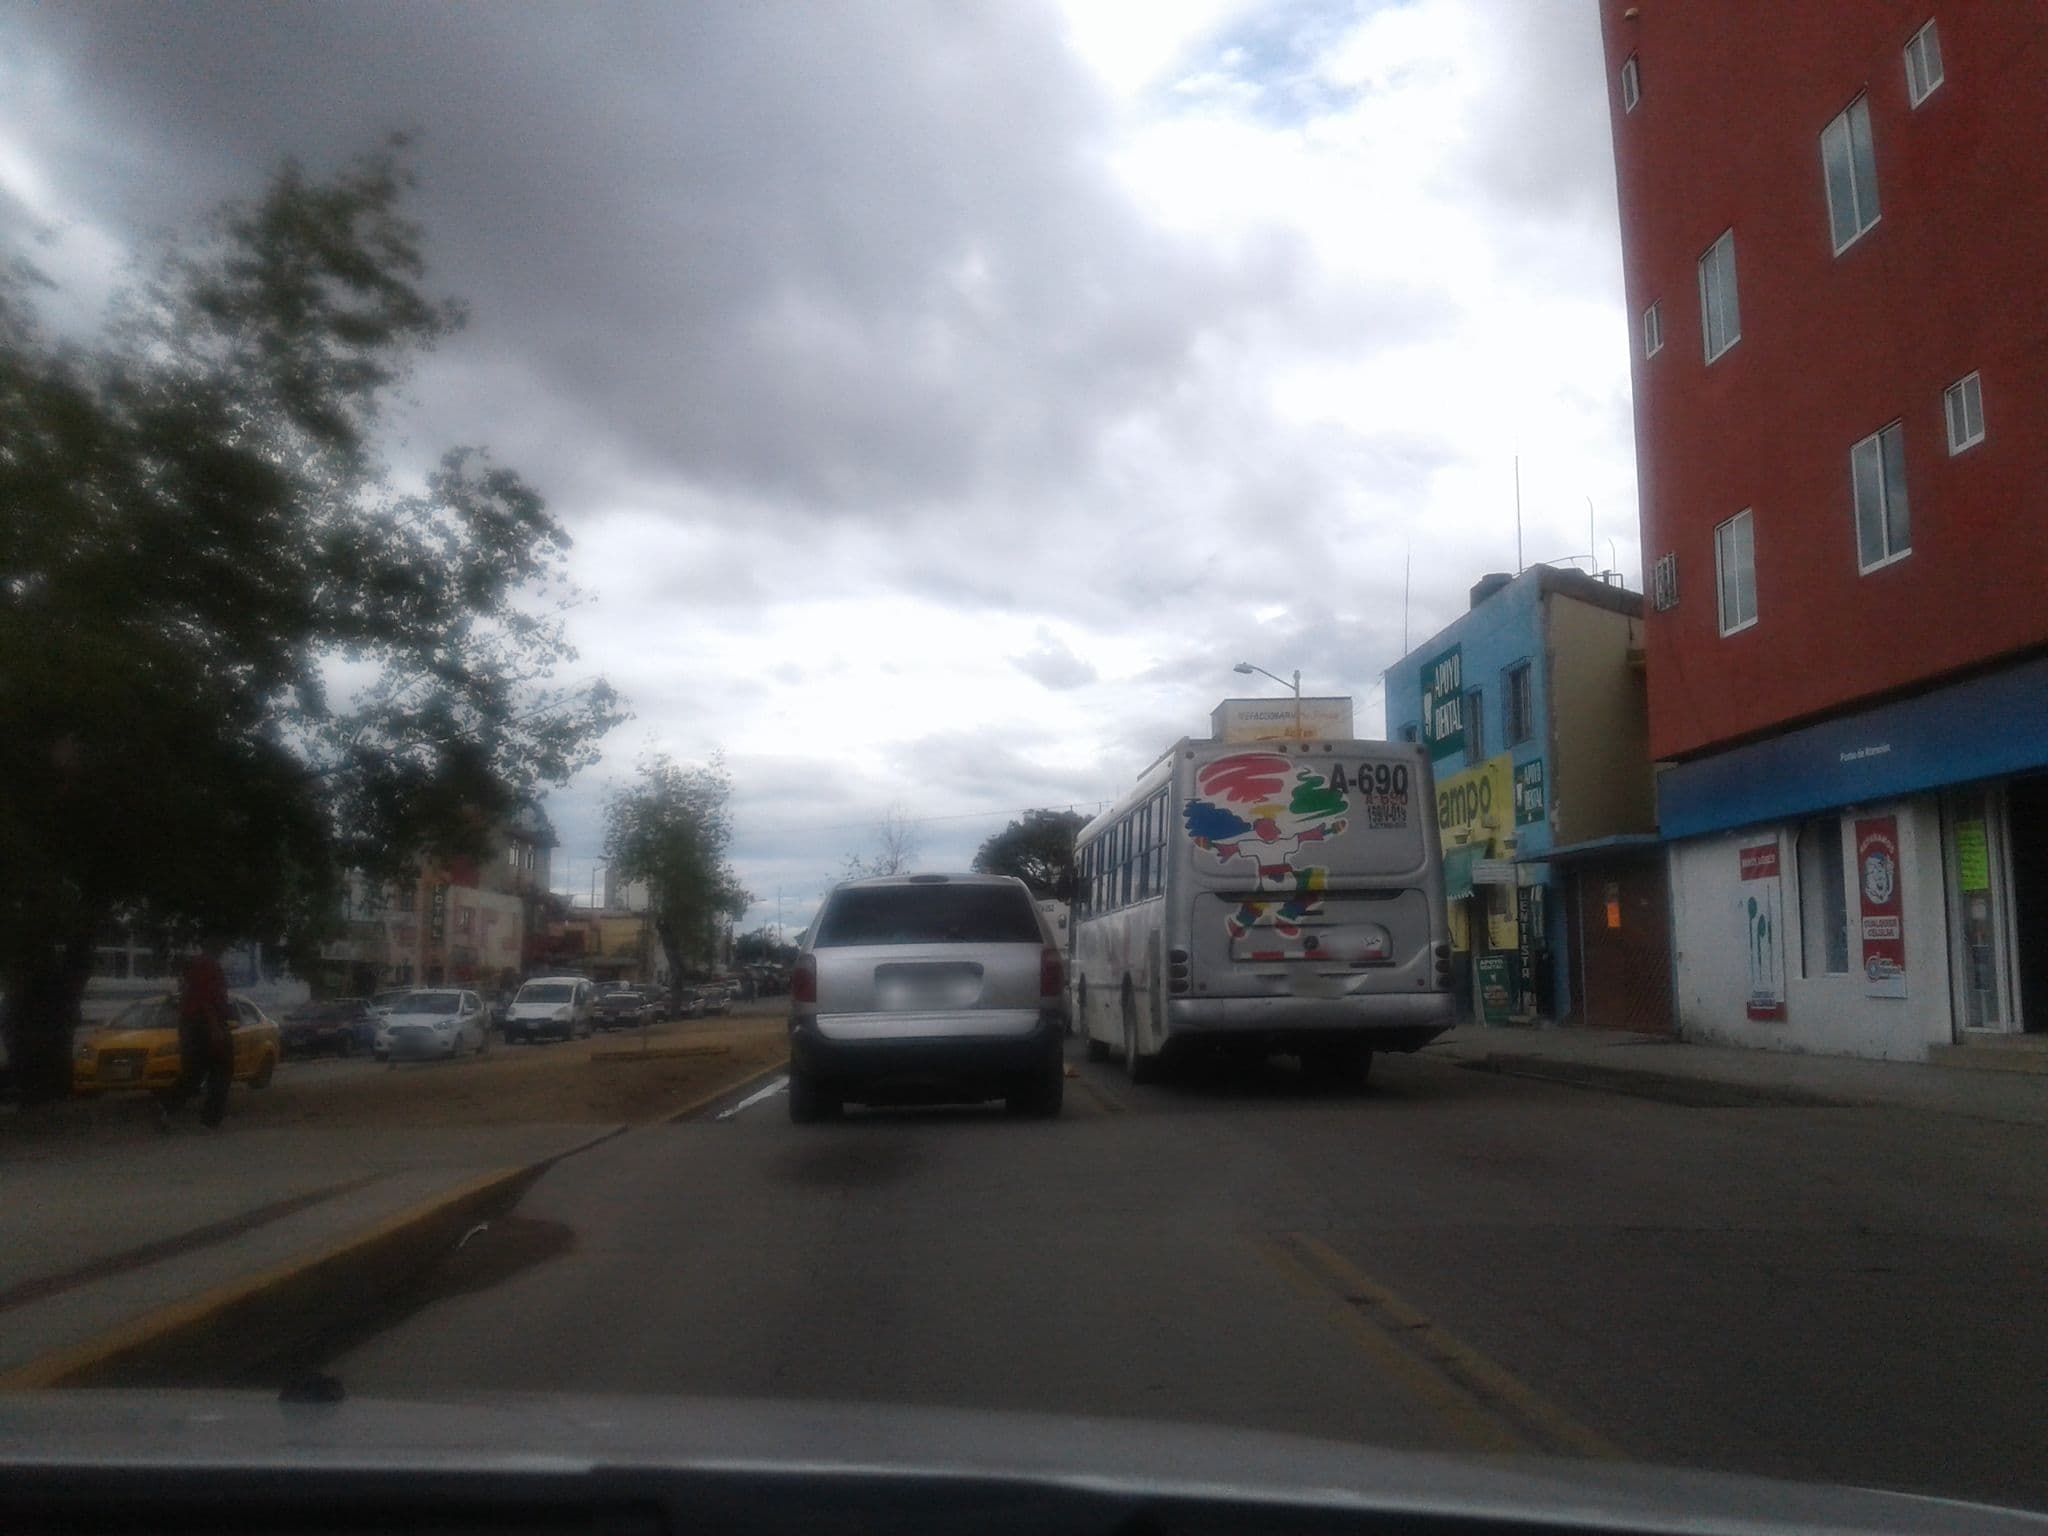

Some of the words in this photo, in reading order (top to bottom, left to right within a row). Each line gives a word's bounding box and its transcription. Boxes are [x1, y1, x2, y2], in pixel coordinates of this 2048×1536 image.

[1435, 653, 1460, 697] APOYO
[1436, 696, 1463, 740] DENTAL
[1330, 763, 1408, 794] A-690
